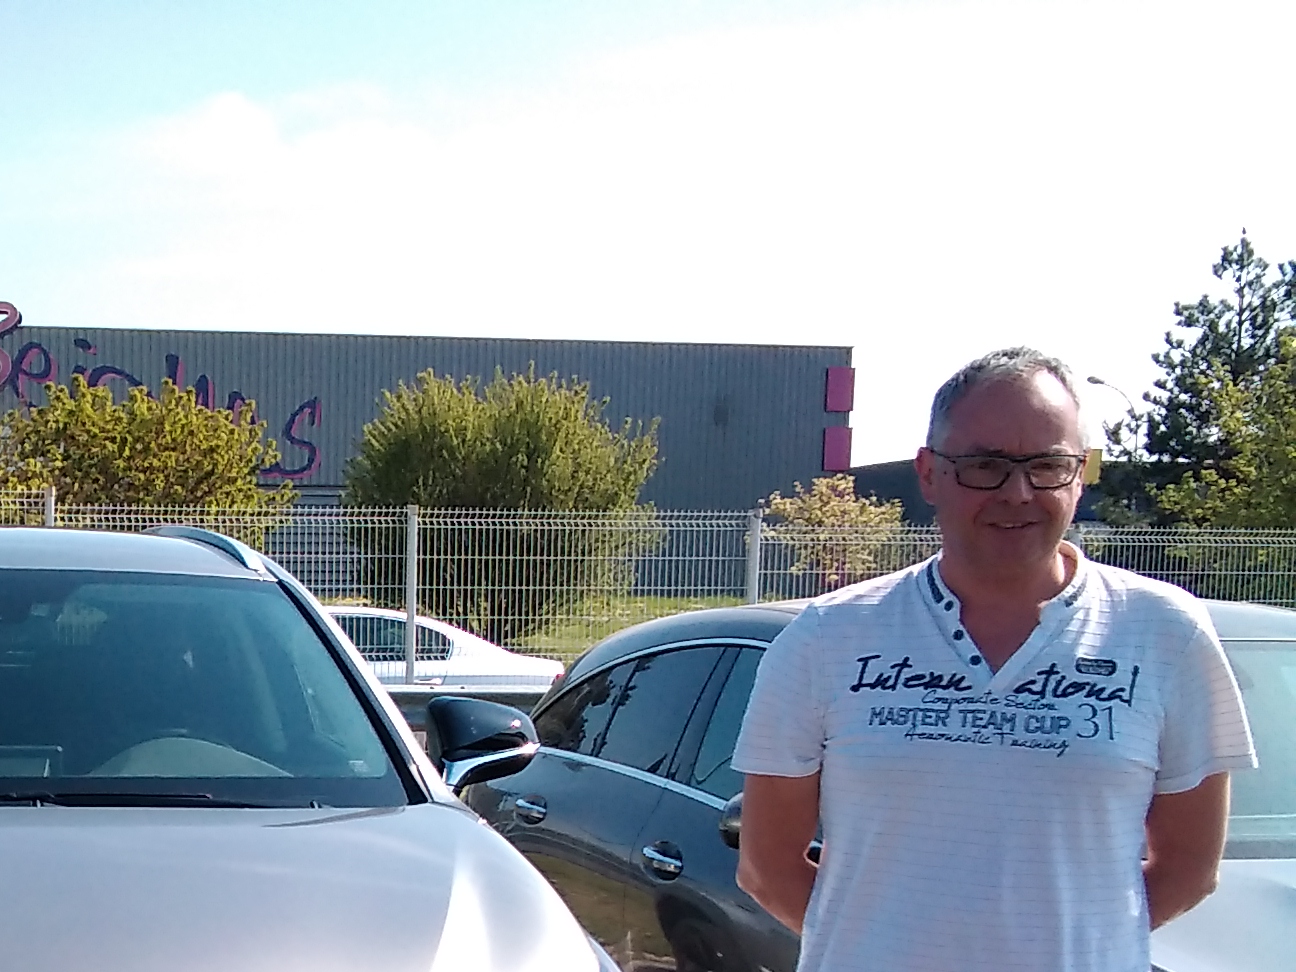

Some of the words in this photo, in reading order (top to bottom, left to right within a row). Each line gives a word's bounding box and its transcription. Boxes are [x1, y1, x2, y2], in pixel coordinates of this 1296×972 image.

[1004, 694, 1059, 711] Sector
[868, 707, 951, 728] MASTER
[958, 709, 1017, 732] TEAM
[1024, 714, 1072, 735] CUP
[1077, 703, 1115, 740] 31
